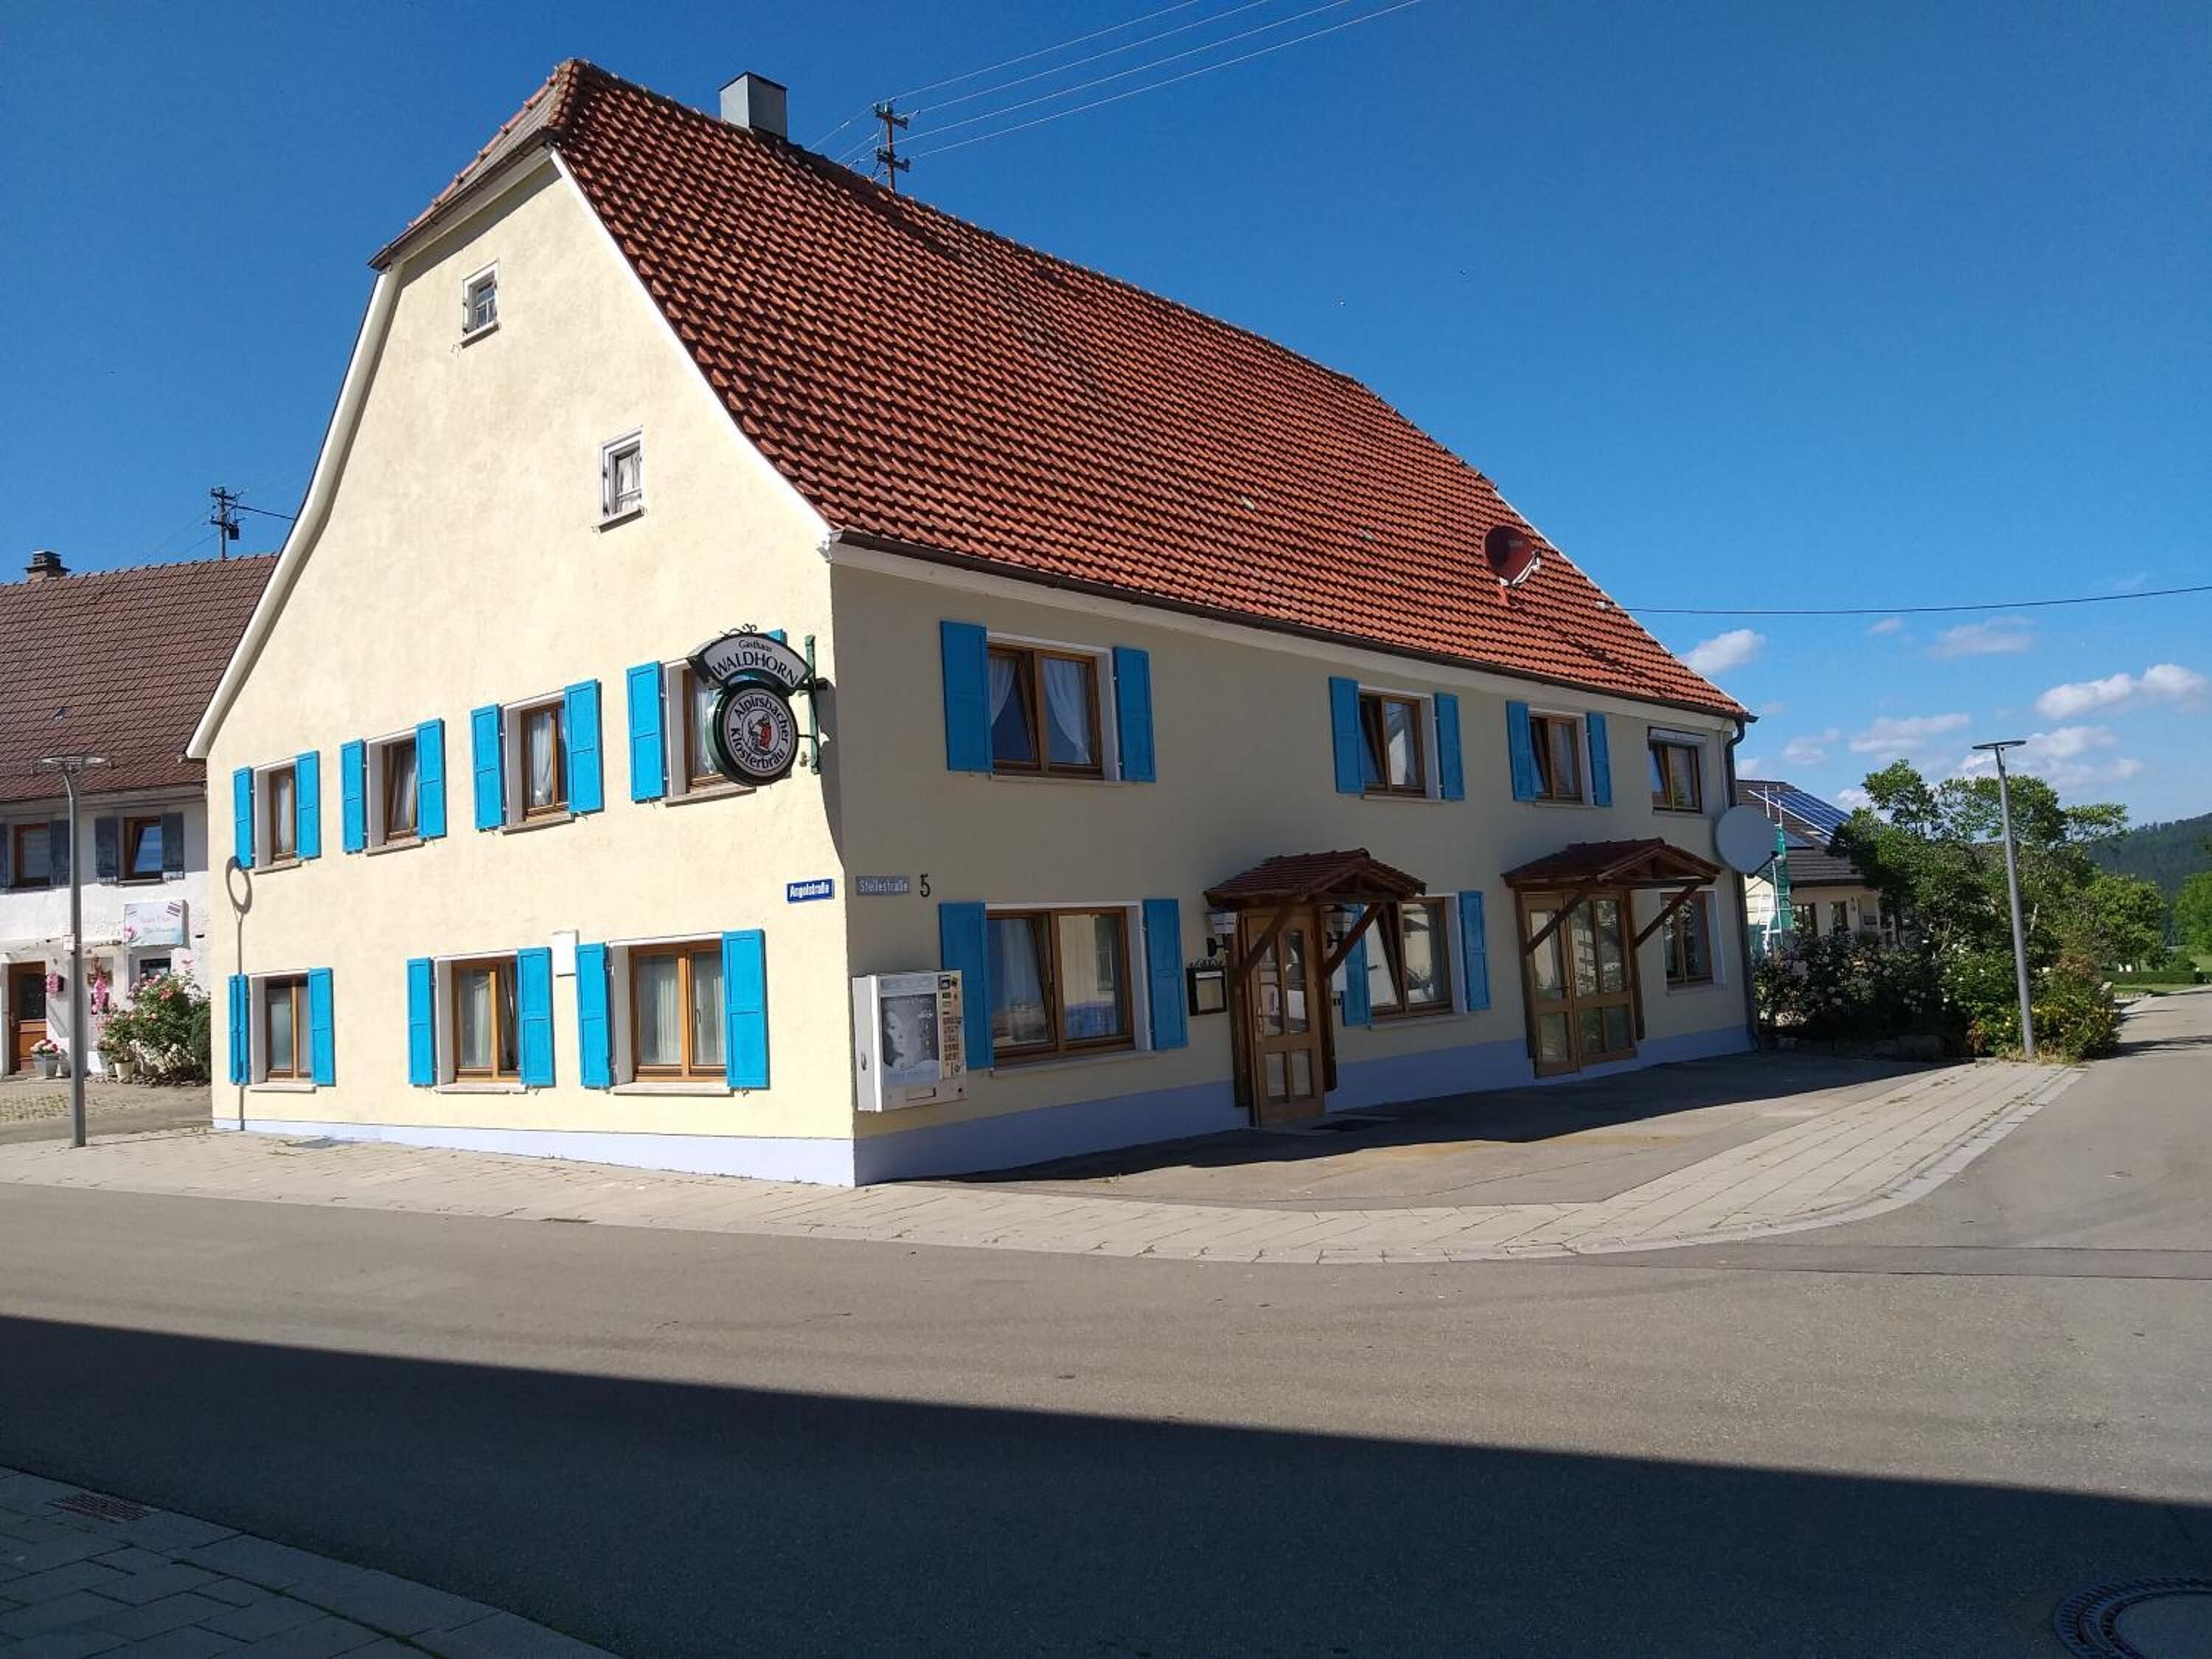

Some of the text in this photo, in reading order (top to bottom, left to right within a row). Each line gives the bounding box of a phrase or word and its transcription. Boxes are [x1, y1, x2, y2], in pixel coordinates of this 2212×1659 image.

[713, 651, 799, 686] WALDHORN
[734, 695, 790, 743] Alpirsbacher
[731, 727, 785, 768] Klosterbräu
[919, 872, 931, 897] 5
